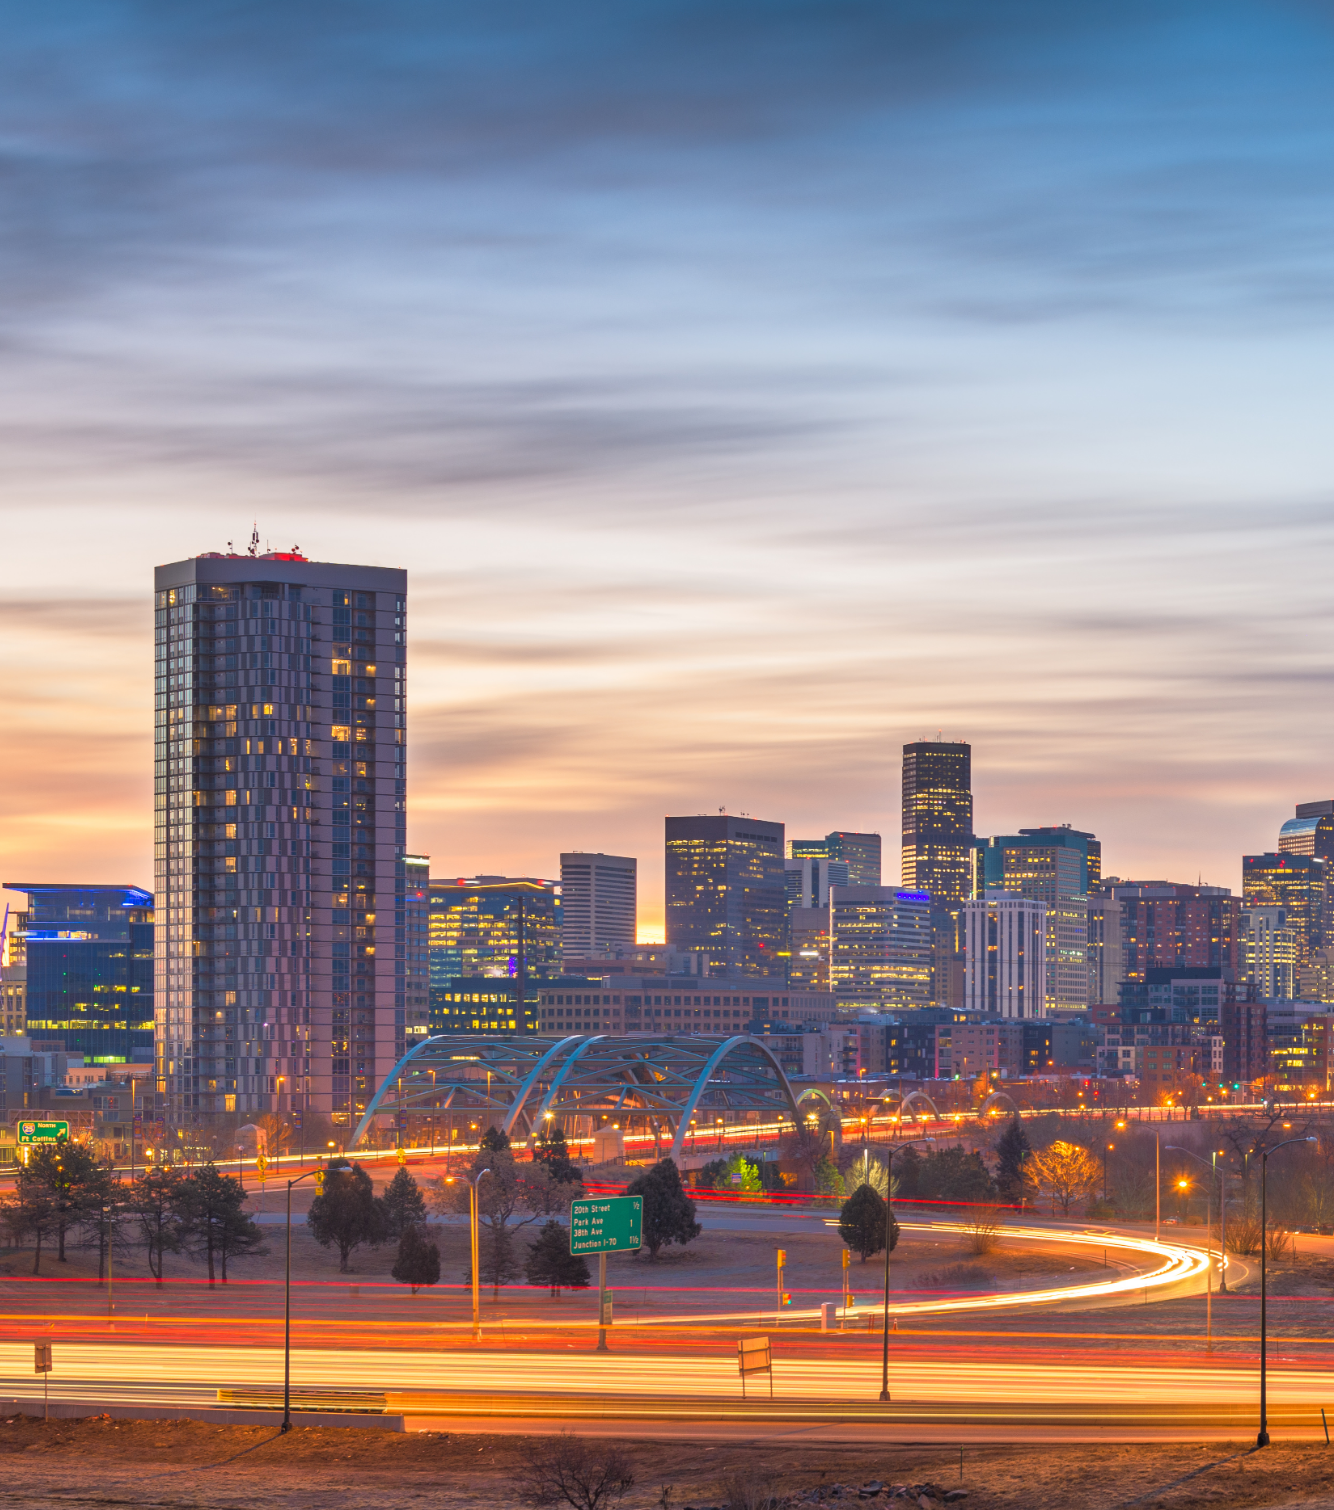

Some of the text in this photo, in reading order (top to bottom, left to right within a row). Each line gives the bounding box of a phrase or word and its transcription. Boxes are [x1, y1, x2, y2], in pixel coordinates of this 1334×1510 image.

[574, 1205, 589, 1214] 20th
[591, 1204, 610, 1213] Street
[573, 1217, 633, 1227] Park Ave 1
[573, 1229, 588, 1237] 38th
[573, 1237, 617, 1249] Junction I-70
